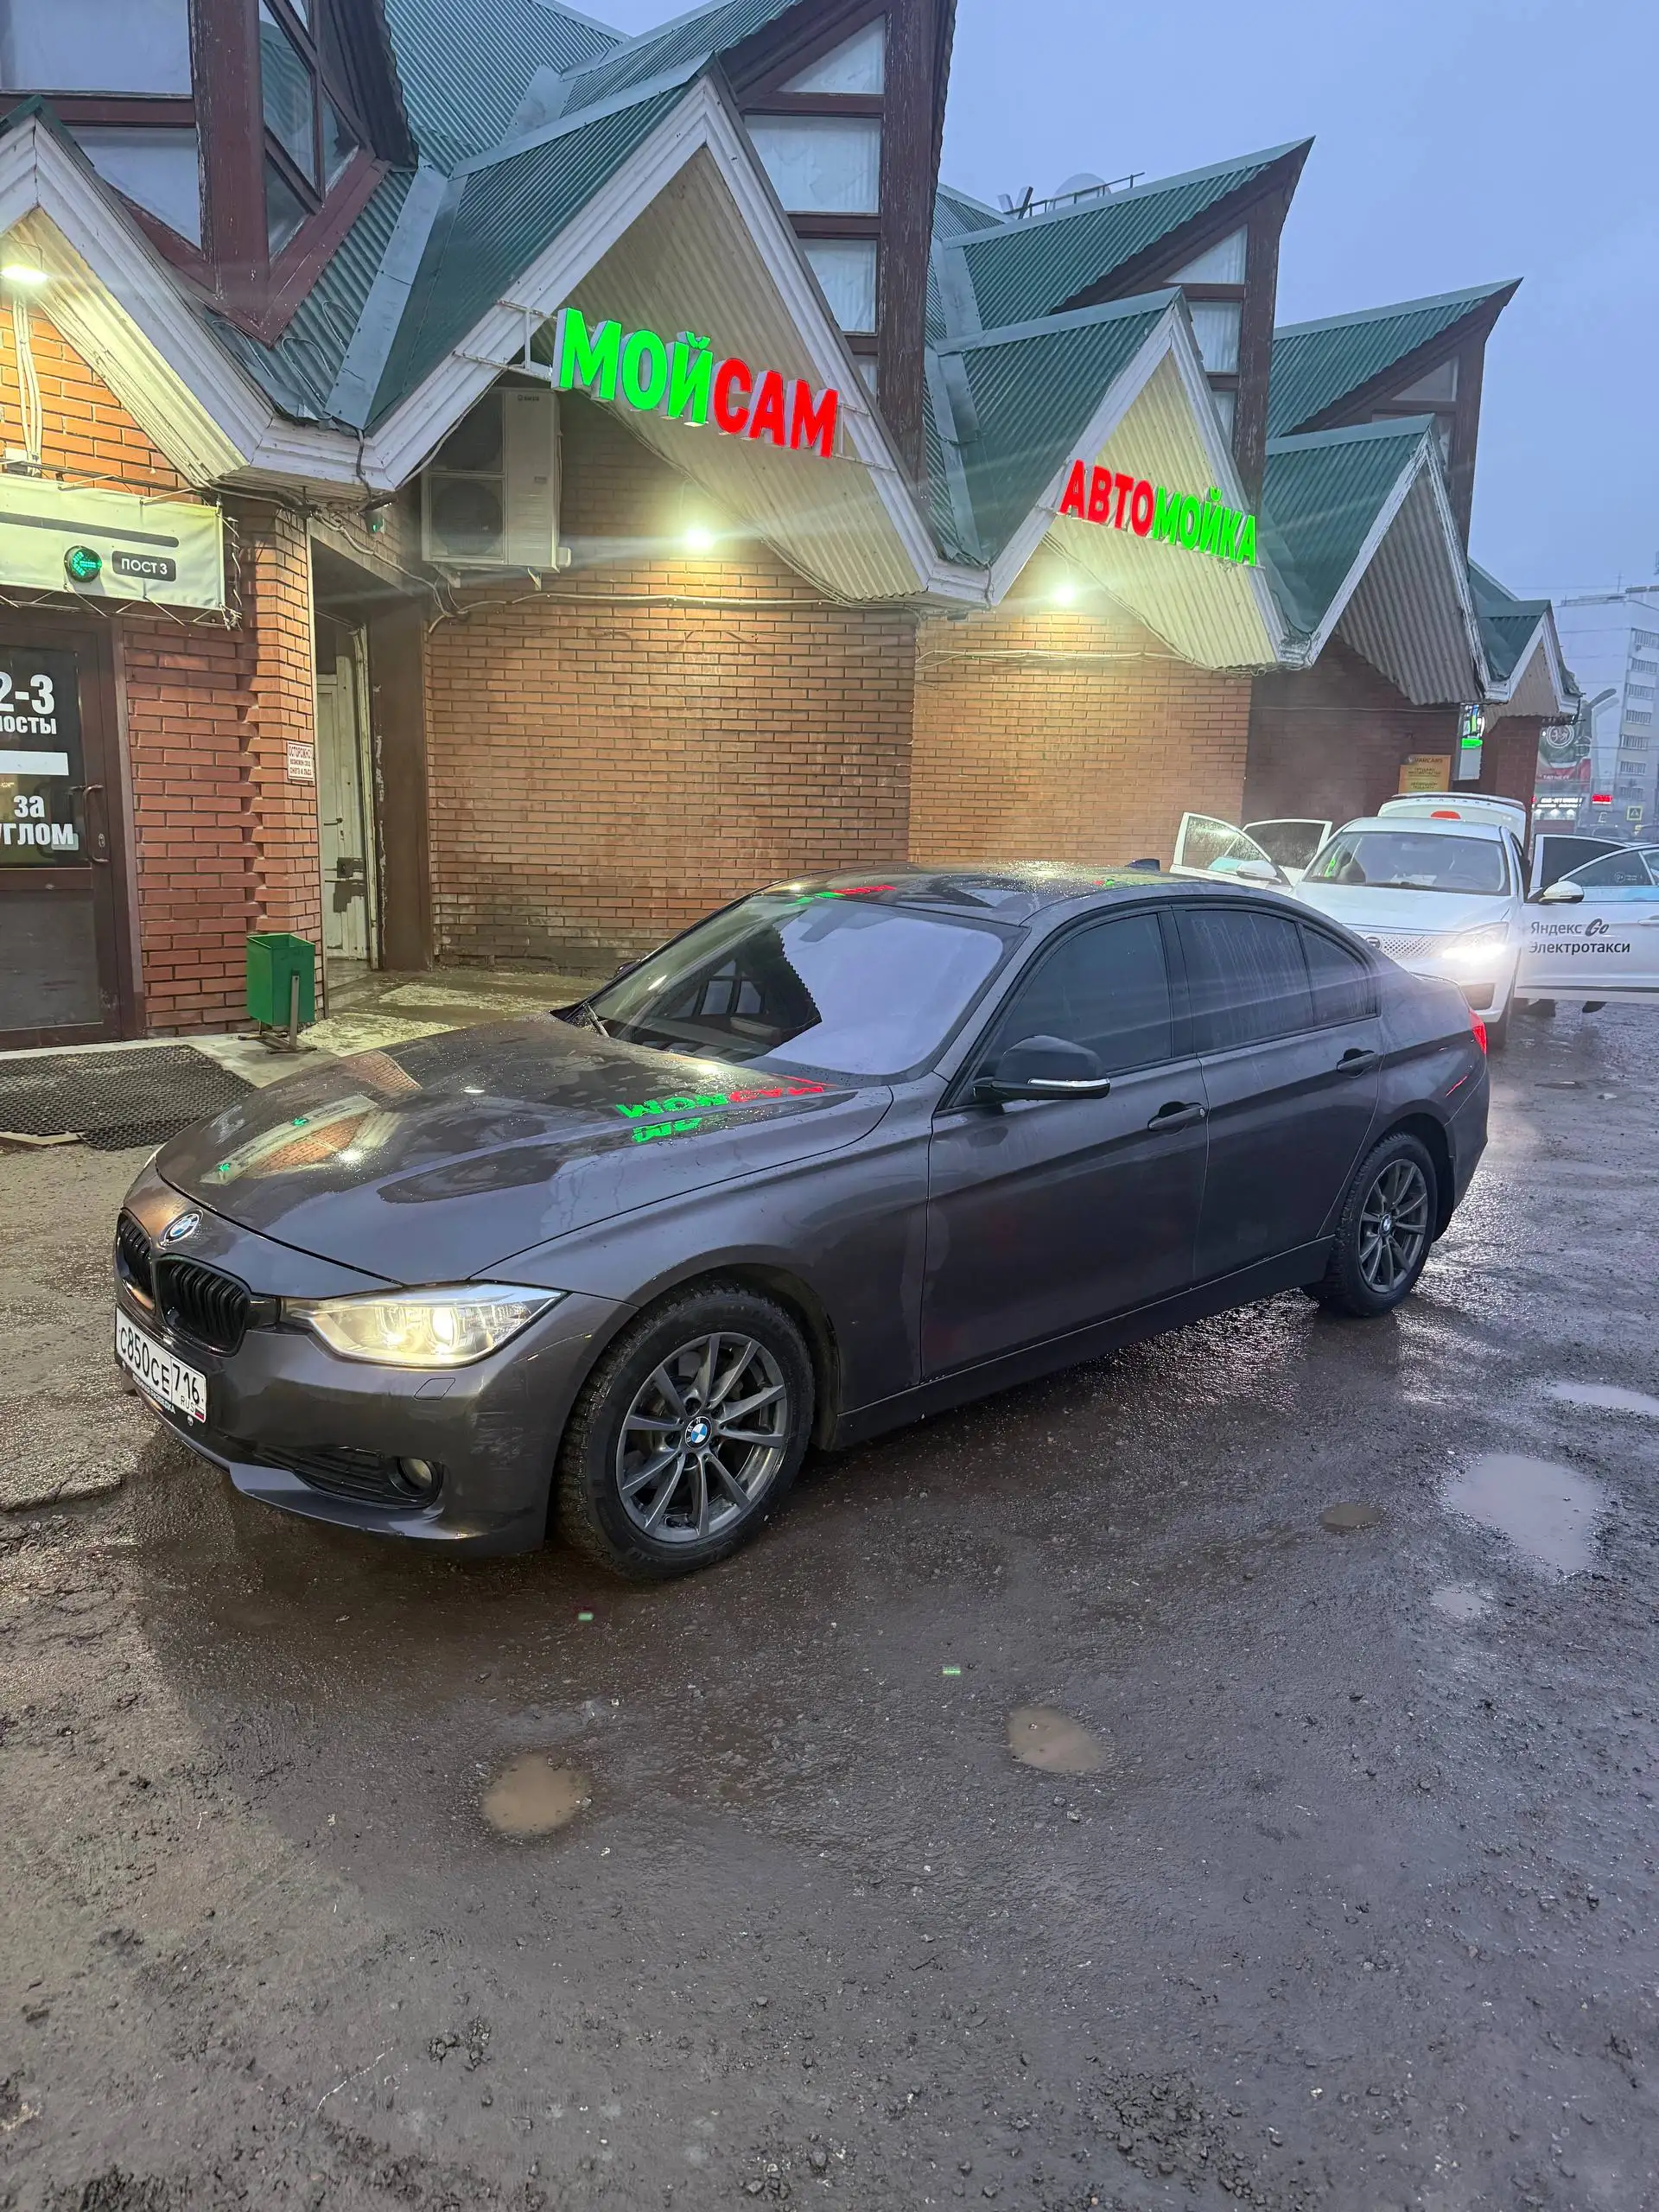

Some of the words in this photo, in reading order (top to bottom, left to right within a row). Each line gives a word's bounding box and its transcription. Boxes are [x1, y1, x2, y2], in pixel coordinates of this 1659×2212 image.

[1059, 459, 1257, 566] АВТОМОЙКА
[121, 557, 157, 574] ПОСТ
[159, 563, 168, 575] 3
[0, 715, 57, 734] осты
[0, 823, 74, 845] глом
[1530, 921, 1583, 936] Яндекс
[1585, 918, 1610, 937] Go
[1529, 941, 1631, 956] Электротакси
[181, 1395, 195, 1414] RUS
